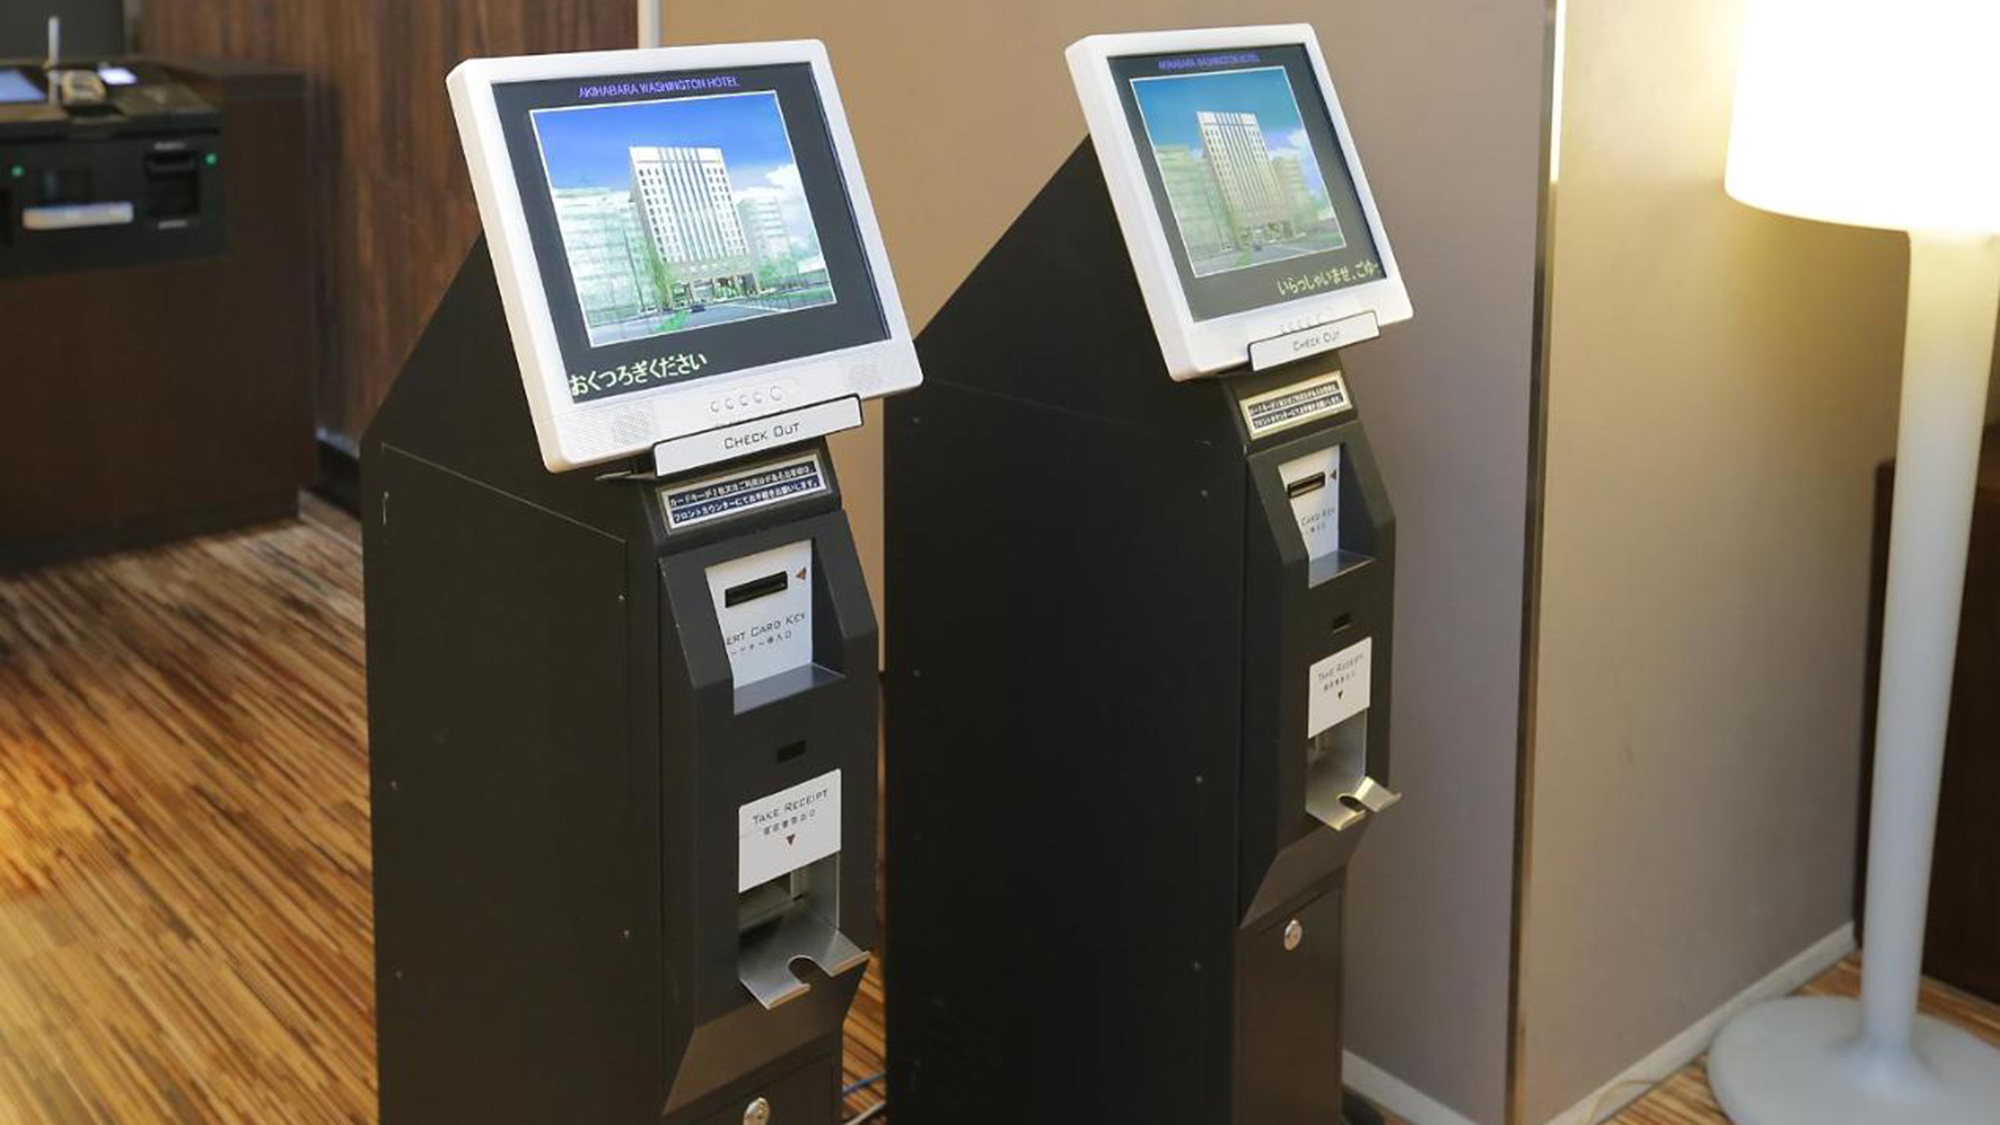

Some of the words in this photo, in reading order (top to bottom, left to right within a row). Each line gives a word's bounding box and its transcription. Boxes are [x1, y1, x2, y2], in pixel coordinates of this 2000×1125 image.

[578, 84, 638, 99] AKIHABARA
[639, 78, 705, 94] WASHINGTON
[708, 76, 740, 88] HOTEL
[569, 353, 708, 396] おくつろぎください
[724, 430, 768, 450] CHECK
[773, 422, 801, 438] OUT
[751, 620, 781, 638] CARD
[786, 612, 805, 625] KEY
[753, 808, 780, 825] TAKE
[784, 789, 828, 811] RECEIPT
